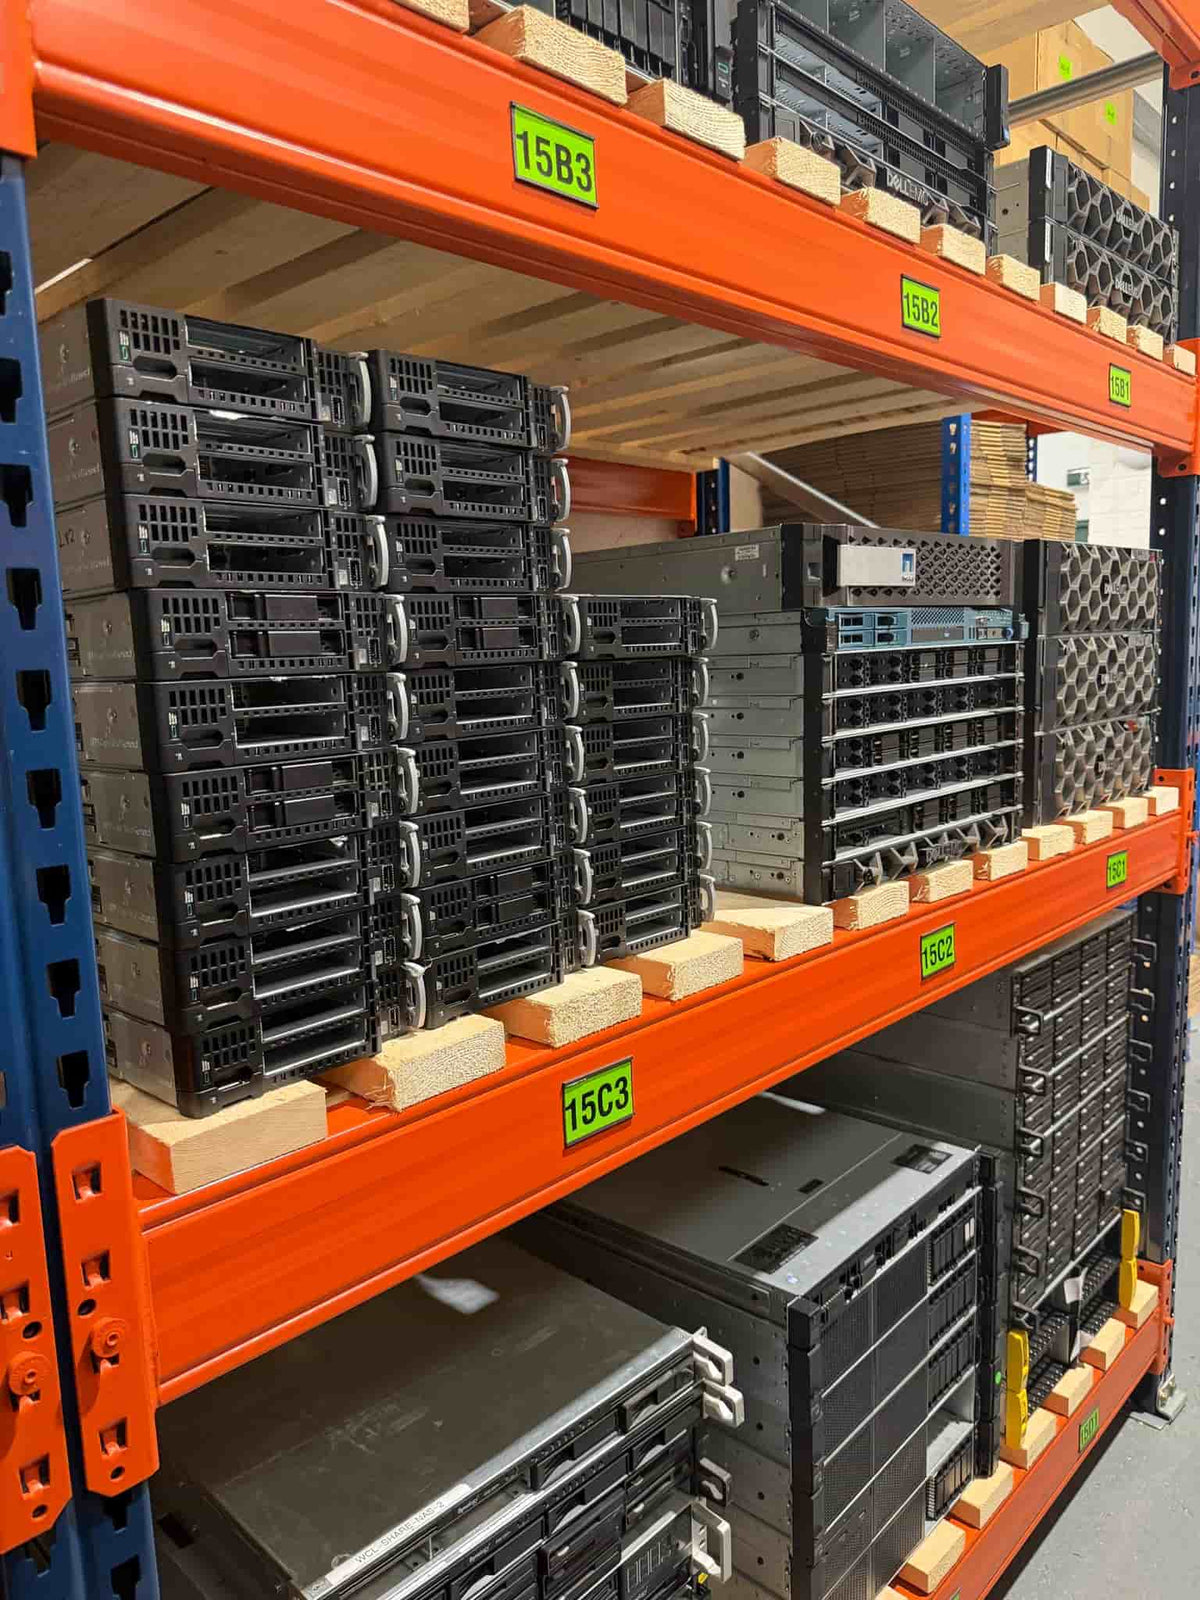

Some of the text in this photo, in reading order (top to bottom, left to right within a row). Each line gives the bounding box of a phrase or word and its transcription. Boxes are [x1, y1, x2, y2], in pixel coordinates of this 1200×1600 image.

[516, 130, 593, 192] 15B3
[903, 291, 938, 328] 15B2
[1111, 375, 1129, 401] 15B1
[1109, 860, 1125, 882] 15C1
[922, 935, 953, 969] 15C2
[565, 1076, 629, 1131] 15C3
[354, 1547, 380, 1563] WCL
[381, 1500, 445, 1547] SHARE-NAS-2
